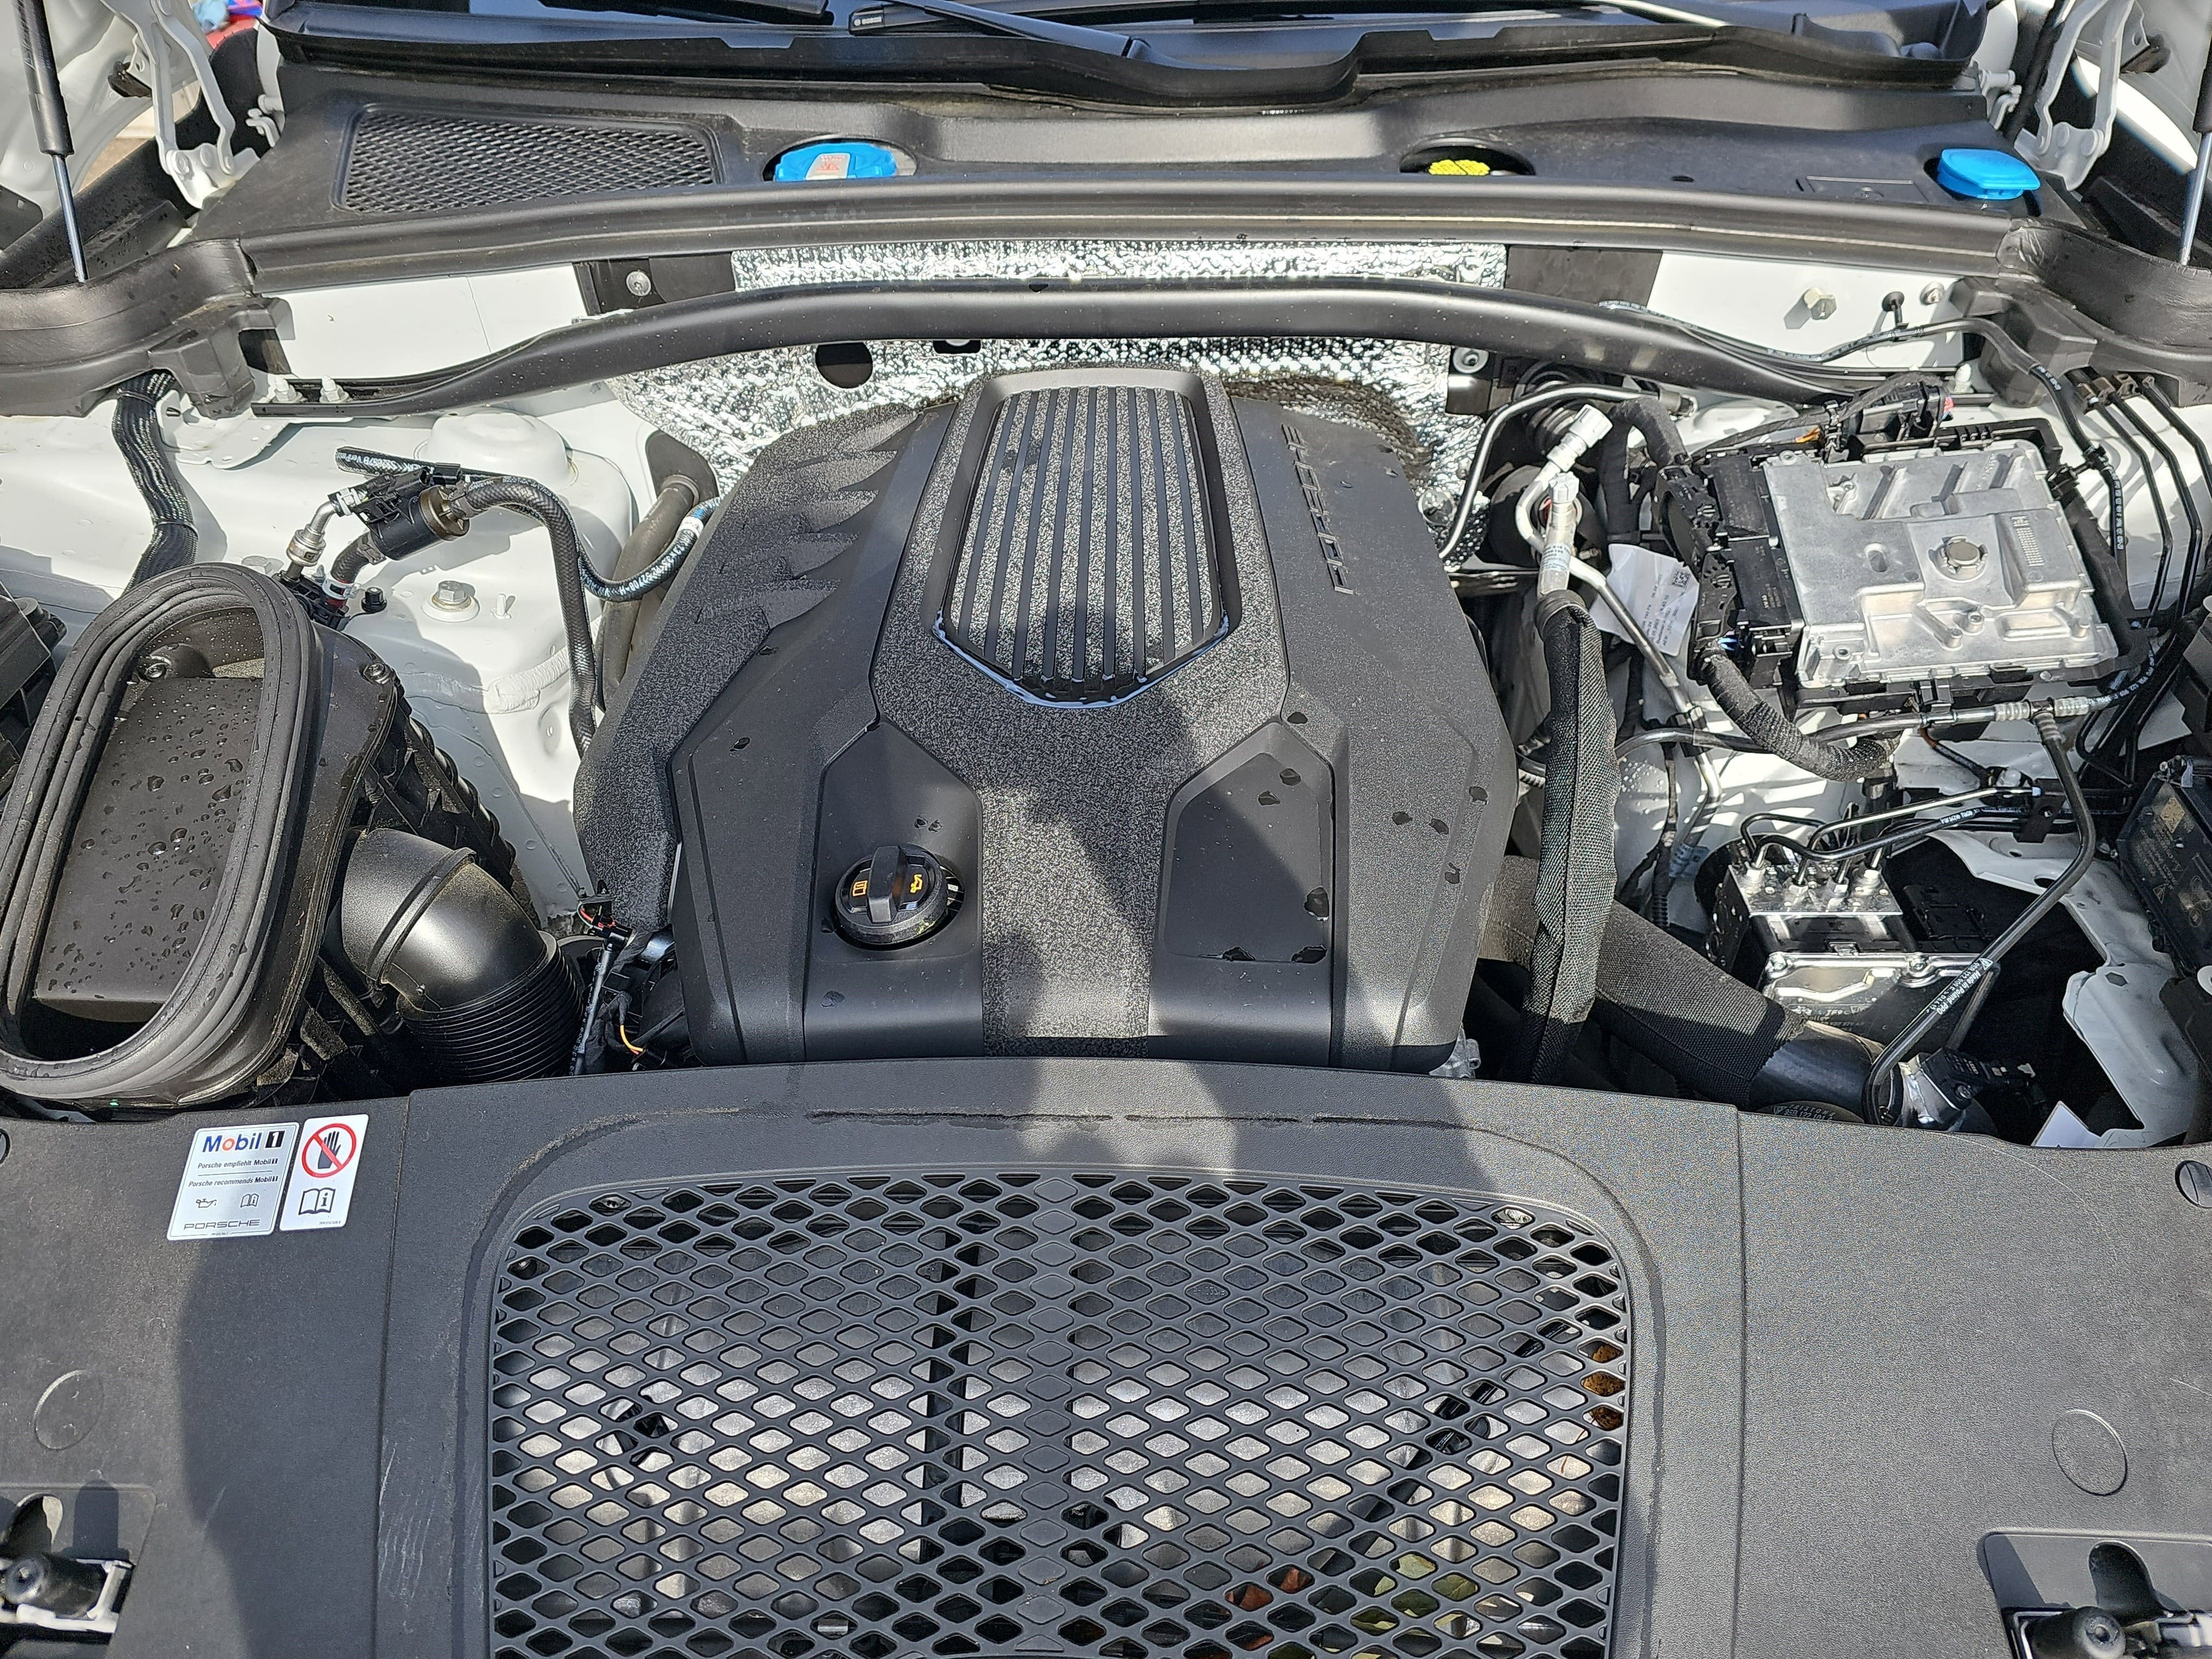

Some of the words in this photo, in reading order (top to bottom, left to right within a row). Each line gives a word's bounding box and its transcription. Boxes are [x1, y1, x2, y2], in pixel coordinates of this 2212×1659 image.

[1281, 423, 1353, 595] PORSCHE
[1969, 970, 1981, 985] Made
[1947, 987, 1965, 1005] Poland
[202, 1132, 262, 1153] Mobil
[224, 1159, 252, 1168] empfiehlt
[214, 1178, 253, 1186] recommends
[183, 1219, 260, 1230] PORSCHE
